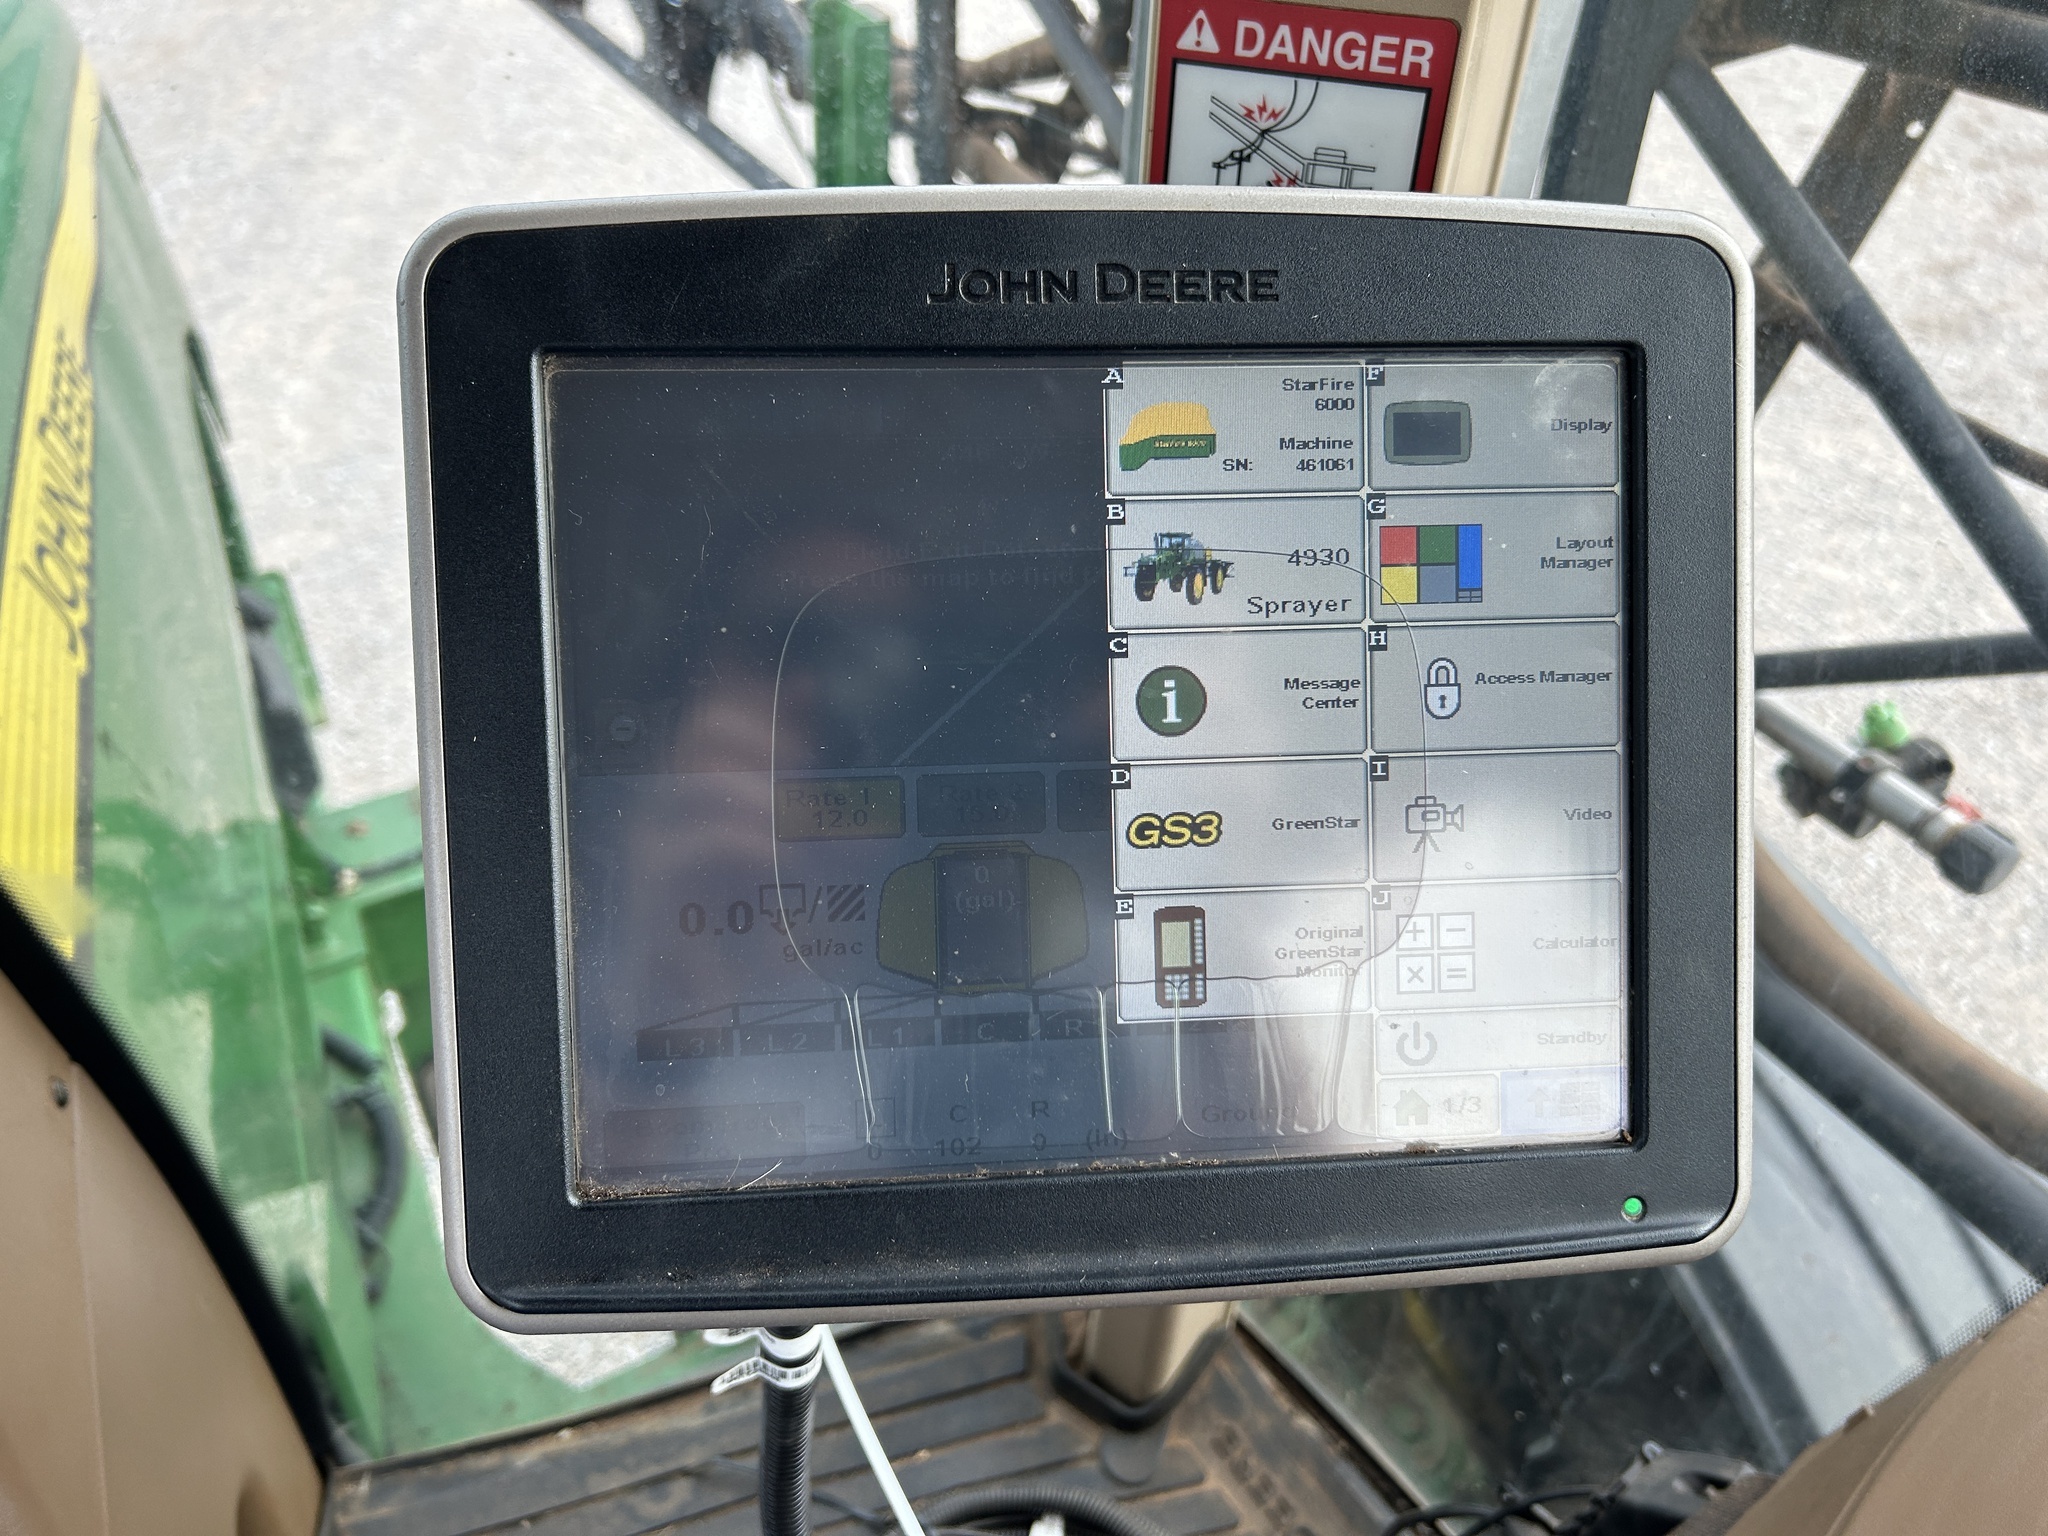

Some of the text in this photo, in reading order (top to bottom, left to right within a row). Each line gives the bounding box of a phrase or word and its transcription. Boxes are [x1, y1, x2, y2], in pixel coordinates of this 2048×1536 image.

[1233, 19, 1435, 78] DANGER
[926, 262, 1280, 305] JOHN DEERE
[1103, 368, 1121, 383] A
[1368, 365, 1384, 380] F
[1282, 377, 1355, 392] StarFire
[1315, 398, 1355, 411] 6000
[1550, 418, 1613, 434] Display
[1279, 436, 1354, 450] Machine
[1222, 457, 1355, 472] SN: 461061
[1107, 505, 1124, 519] B
[1367, 499, 1386, 514] G
[1556, 536, 1614, 551] Layout
[19, 462, 91, 656] JOHN
[1287, 548, 1351, 567] 4930
[1540, 557, 1614, 572] Manager
[1247, 597, 1352, 616] Sprayer
[1110, 638, 1127, 653] C
[1369, 631, 1387, 645] H
[1475, 668, 1613, 685] Access Manager
[1284, 677, 1361, 692] Message
[1302, 696, 1359, 710] Center
[1112, 770, 1130, 784] D
[812, 808, 868, 829] 12.0
[1563, 807, 1613, 822] Video
[1126, 811, 1223, 849] GS3
[1272, 816, 1361, 831] GreenStar
[1116, 900, 1133, 913] E
[678, 899, 754, 936] 0.0
[1295, 925, 1364, 940] Original
[1533, 934, 1617, 950] Calculator
[782, 939, 863, 962] gal/ac
[1275, 945, 1364, 960] GreenStar
[1537, 1031, 1607, 1047] Standby
[949, 1103, 969, 1123] C
[1031, 1099, 1050, 1119] R
[935, 1137, 982, 1157] 102
